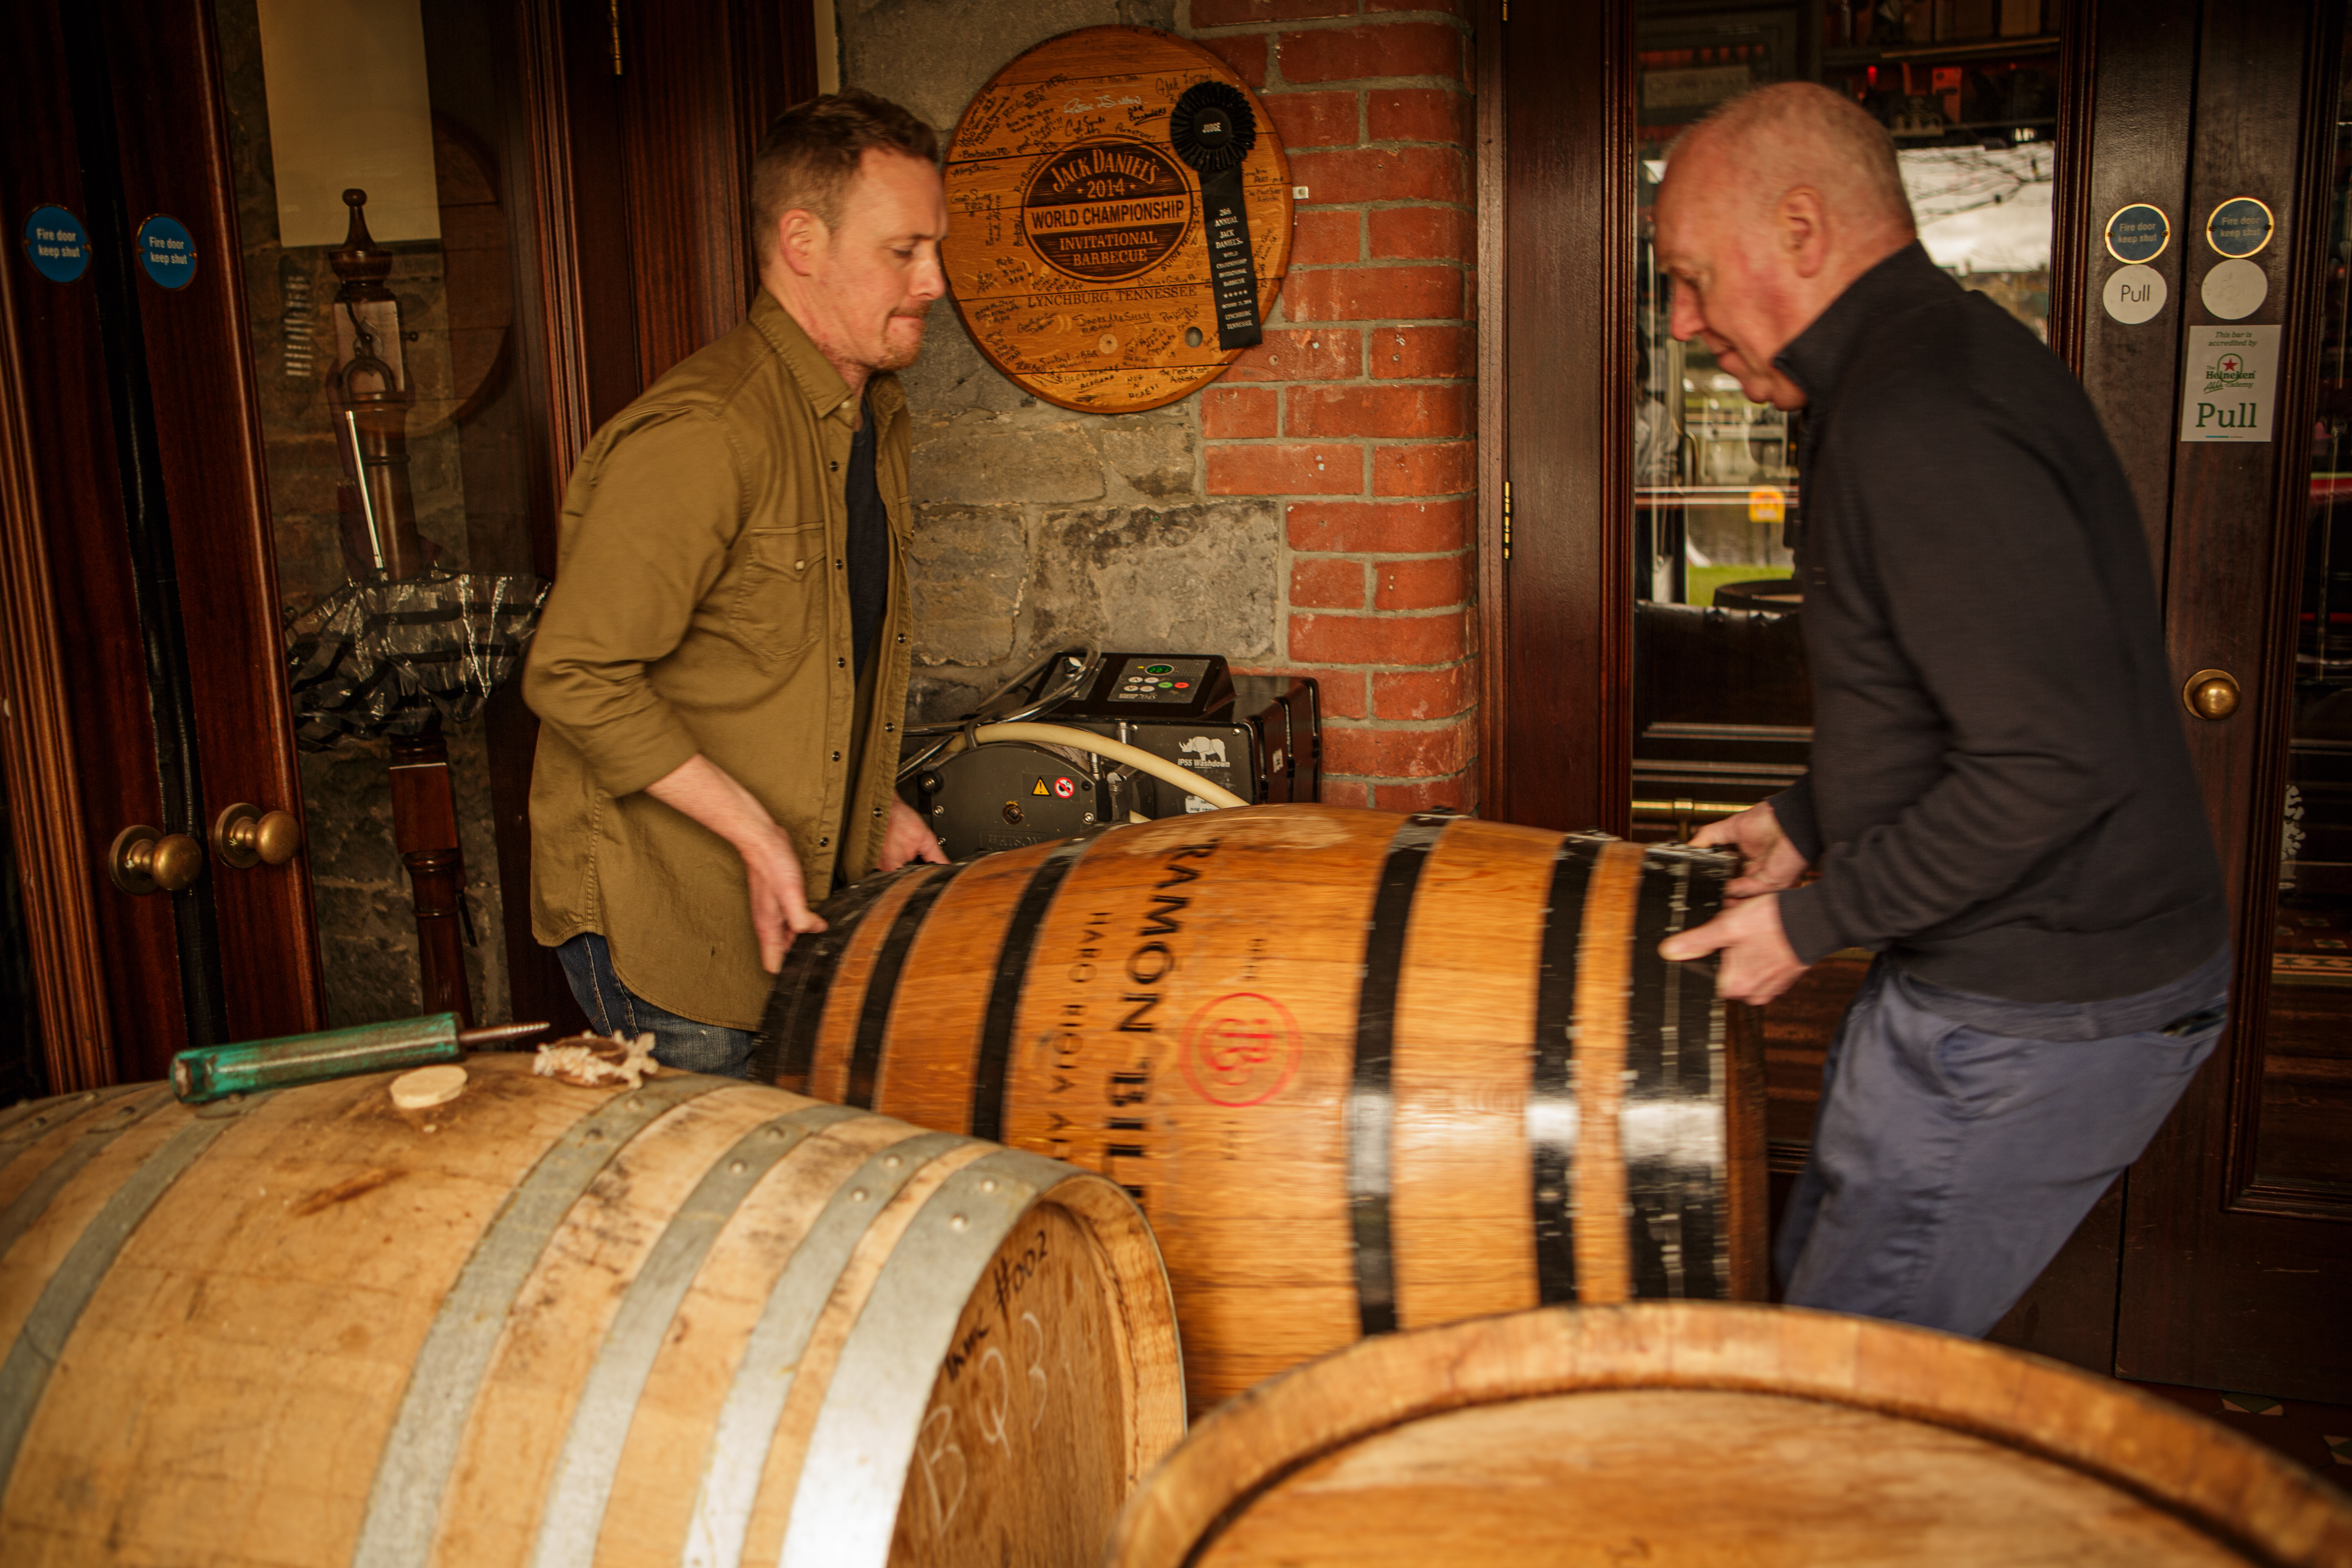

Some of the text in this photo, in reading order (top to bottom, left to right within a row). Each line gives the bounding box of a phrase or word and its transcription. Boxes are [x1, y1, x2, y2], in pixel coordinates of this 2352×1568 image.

[1202, 122, 1222, 134] JUDGE
[1050, 157, 1093, 192] JACK
[1091, 149, 1160, 185] DANIEL'S
[1087, 178, 1125, 198] 2014
[1031, 209, 1079, 229] WORLD
[1082, 199, 1185, 225] CHAMPIONSHIP
[1214, 216, 1239, 227] ANNUAL
[2119, 223, 2156, 232] Fire door
[2221, 216, 2261, 226] Fire door
[36, 228, 77, 243] Fire door
[1220, 229, 1235, 239] JACK
[2118, 233, 2158, 245] keep shut
[2220, 227, 2261, 239] keep shut
[149, 236, 185, 250] Fire door
[1060, 231, 1158, 251] INVITATIONAL
[38, 243, 81, 259] keep shut
[150, 252, 188, 265] keep shut
[1073, 249, 1148, 267] BARBECUE
[1216, 258, 1247, 270] CHAMPIONSHIP
[1218, 268, 1247, 278] INVITATIONAL
[1027, 285, 1197, 307] LYNCHBURG, TENNESSEE
[2120, 284, 2150, 303] Pull
[2195, 402, 2257, 428] Pull
[1177, 758, 1230, 768] IP55 Washdown
